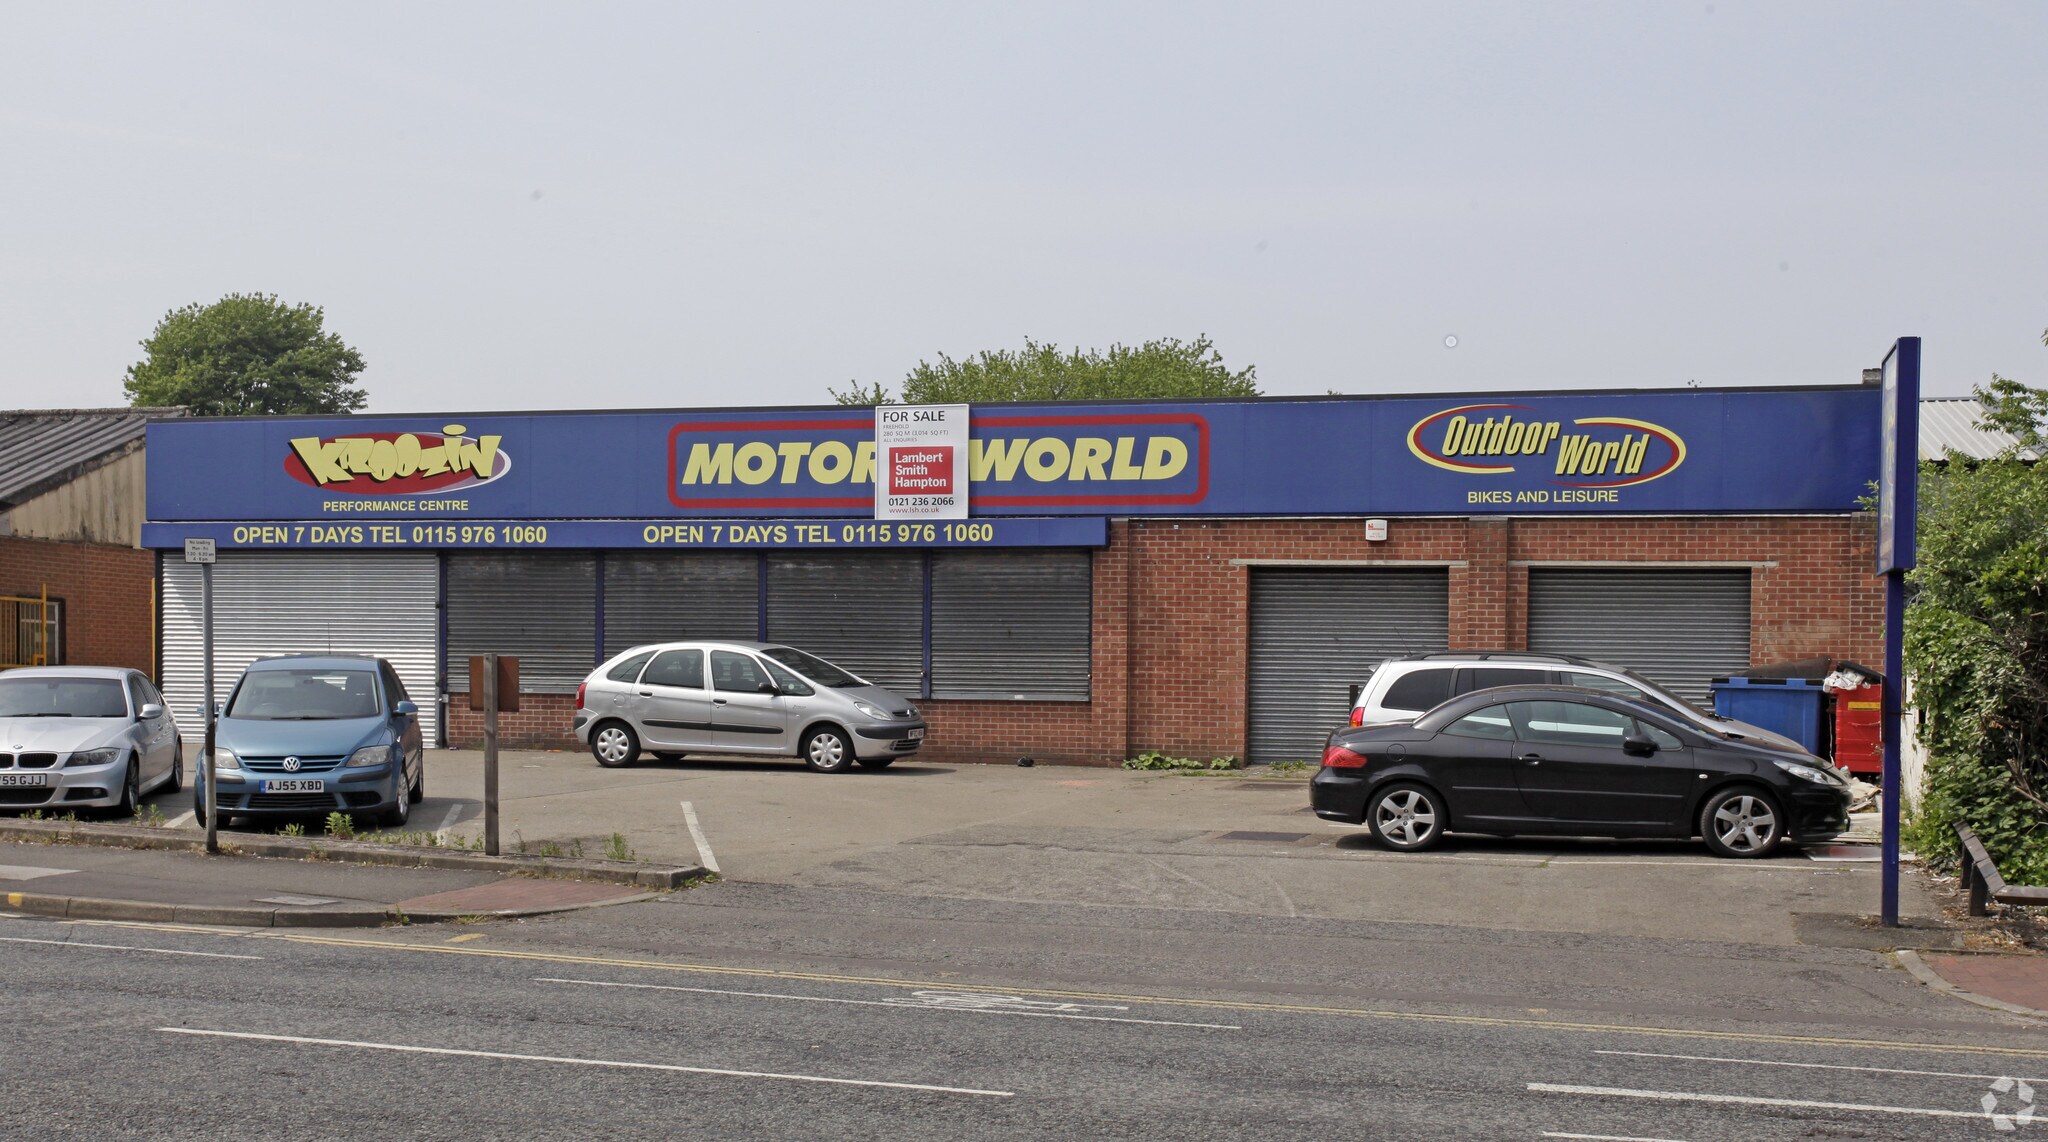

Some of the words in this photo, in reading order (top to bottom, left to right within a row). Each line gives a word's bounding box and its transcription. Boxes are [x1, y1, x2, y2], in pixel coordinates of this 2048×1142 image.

[883, 411, 908, 422] FOR
[913, 410, 945, 422] SALE
[1441, 415, 1560, 455] Outdoor
[895, 452, 943, 463] Lambert
[969, 437, 1187, 482] WORLD
[1555, 433, 1650, 475] World
[895, 465, 928, 475] Smith
[895, 477, 946, 489] Hampton
[888, 498, 909, 506] 0121
[912, 498, 928, 506] 236
[932, 497, 954, 506] 2066
[1468, 491, 1512, 503] BIKES
[1516, 491, 1549, 503] AND
[1553, 490, 1618, 502] LEISURE
[323, 500, 416, 511] PERFORMANCE
[419, 500, 468, 510] CENTRE
[233, 526, 288, 544] OPEN
[294, 526, 305, 543] 7
[311, 526, 363, 543] DAYS
[369, 526, 407, 542] TEL
[412, 526, 456, 543] 0115
[461, 526, 496, 543] 976
[502, 526, 547, 543] 1060
[643, 525, 703, 543] OPEN
[711, 526, 723, 543] 7
[729, 525, 787, 543] DAYS
[794, 525, 836, 543] TEL
[842, 525, 891, 543] 0115
[897, 524, 936, 542] 976
[943, 524, 994, 542] 1060
[0, 776, 16, 785] 59
[20, 776, 42, 785] GJJ
[268, 781, 296, 790] AJ55
[300, 781, 322, 790] XBD
